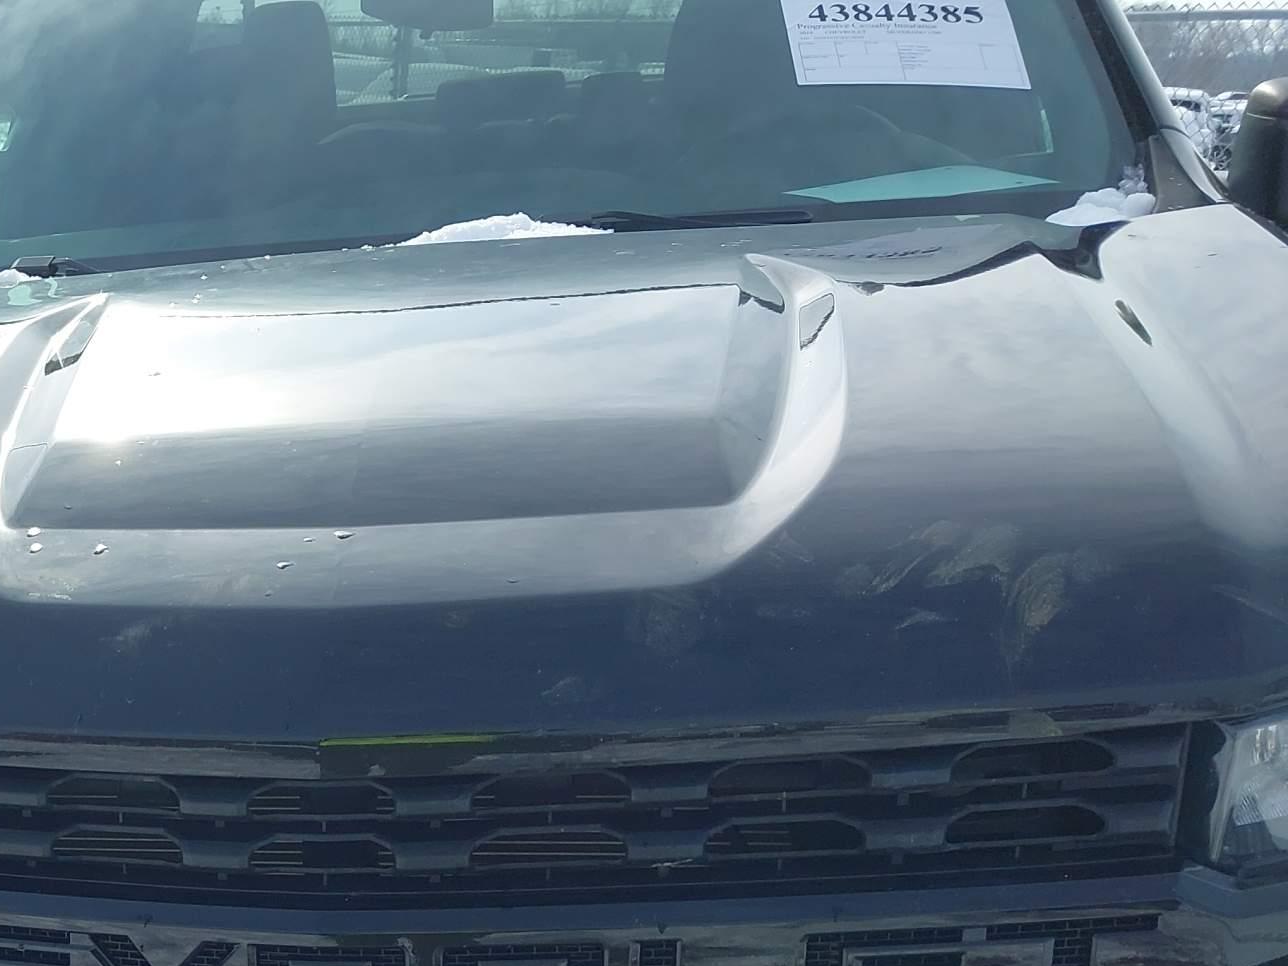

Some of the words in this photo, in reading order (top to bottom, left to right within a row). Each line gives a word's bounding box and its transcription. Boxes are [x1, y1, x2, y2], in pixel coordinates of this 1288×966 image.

[808, 2, 984, 24] 43844385
[797, 23, 849, 31] Progressive
[851, 22, 891, 31] Casualty
